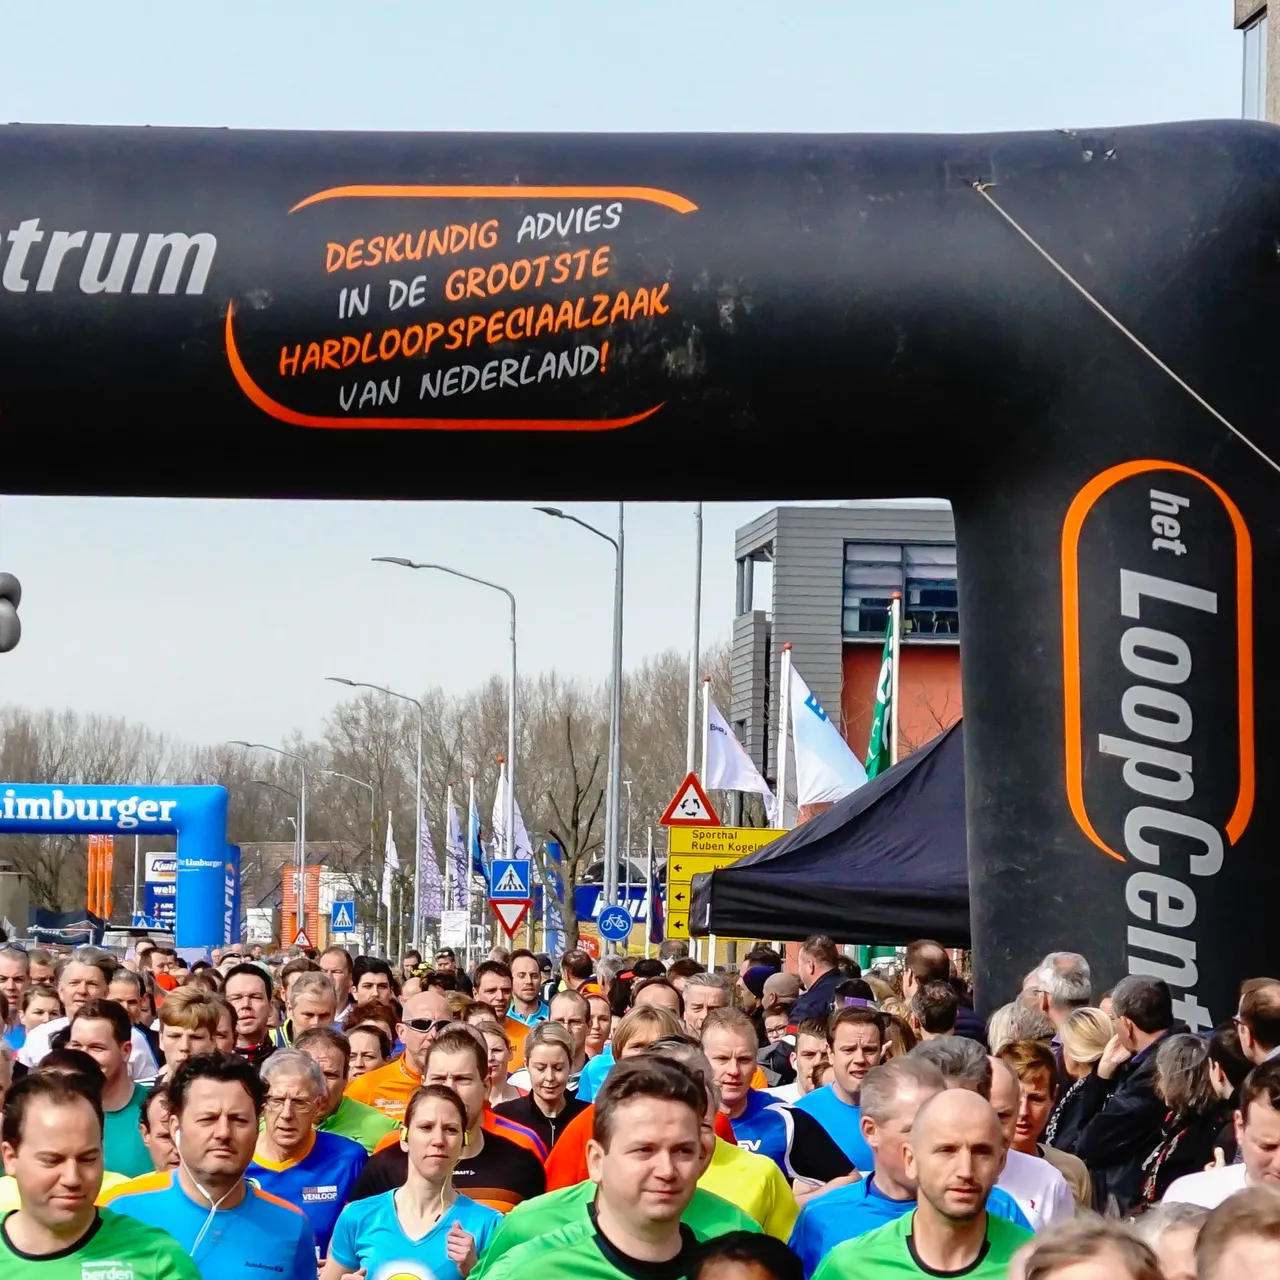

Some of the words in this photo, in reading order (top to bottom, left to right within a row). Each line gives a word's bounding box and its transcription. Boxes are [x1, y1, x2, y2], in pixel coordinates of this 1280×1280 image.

[326, 218, 499, 273] DESKUNDIG
[517, 202, 623, 243] ADVIES
[338, 283, 370, 319] IN
[388, 274, 428, 312] DE
[444, 245, 612, 302] GROOTSTE
[279, 282, 671, 377] HARDLOOPSPECIAALZAAK
[338, 370, 401, 412] VAN
[419, 345, 609, 400] NEDERLAND!
[1149, 488, 1190, 556] het
[691, 841, 725, 851] Ruben
[692, 829, 738, 841] Sporthal
[302, 1192, 338, 1201] VENLOOP
